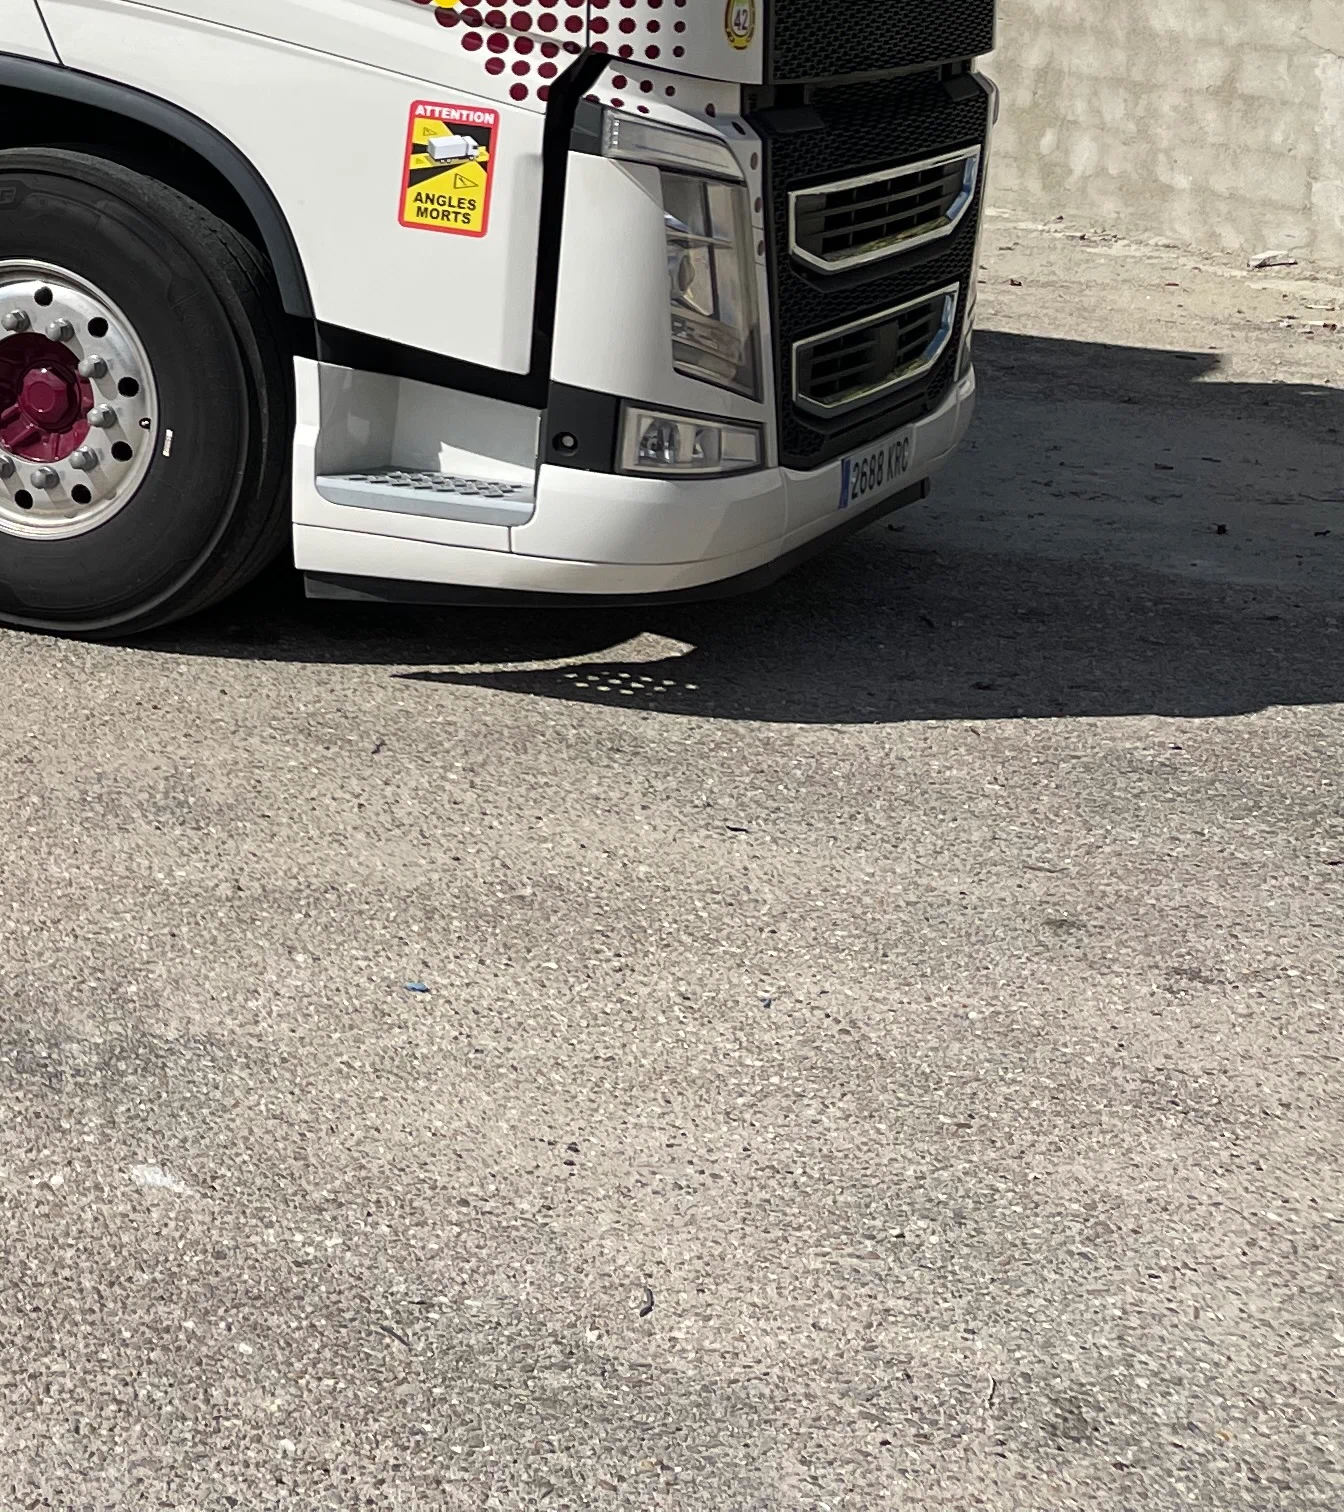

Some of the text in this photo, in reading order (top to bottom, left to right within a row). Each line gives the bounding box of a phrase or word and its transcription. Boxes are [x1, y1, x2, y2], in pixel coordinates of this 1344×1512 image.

[733, 8, 749, 31] 42
[415, 105, 495, 125] ATTENTION
[413, 191, 477, 211] ANGLES
[416, 206, 471, 224] MORTS
[851, 437, 909, 500] 2688 KRC
